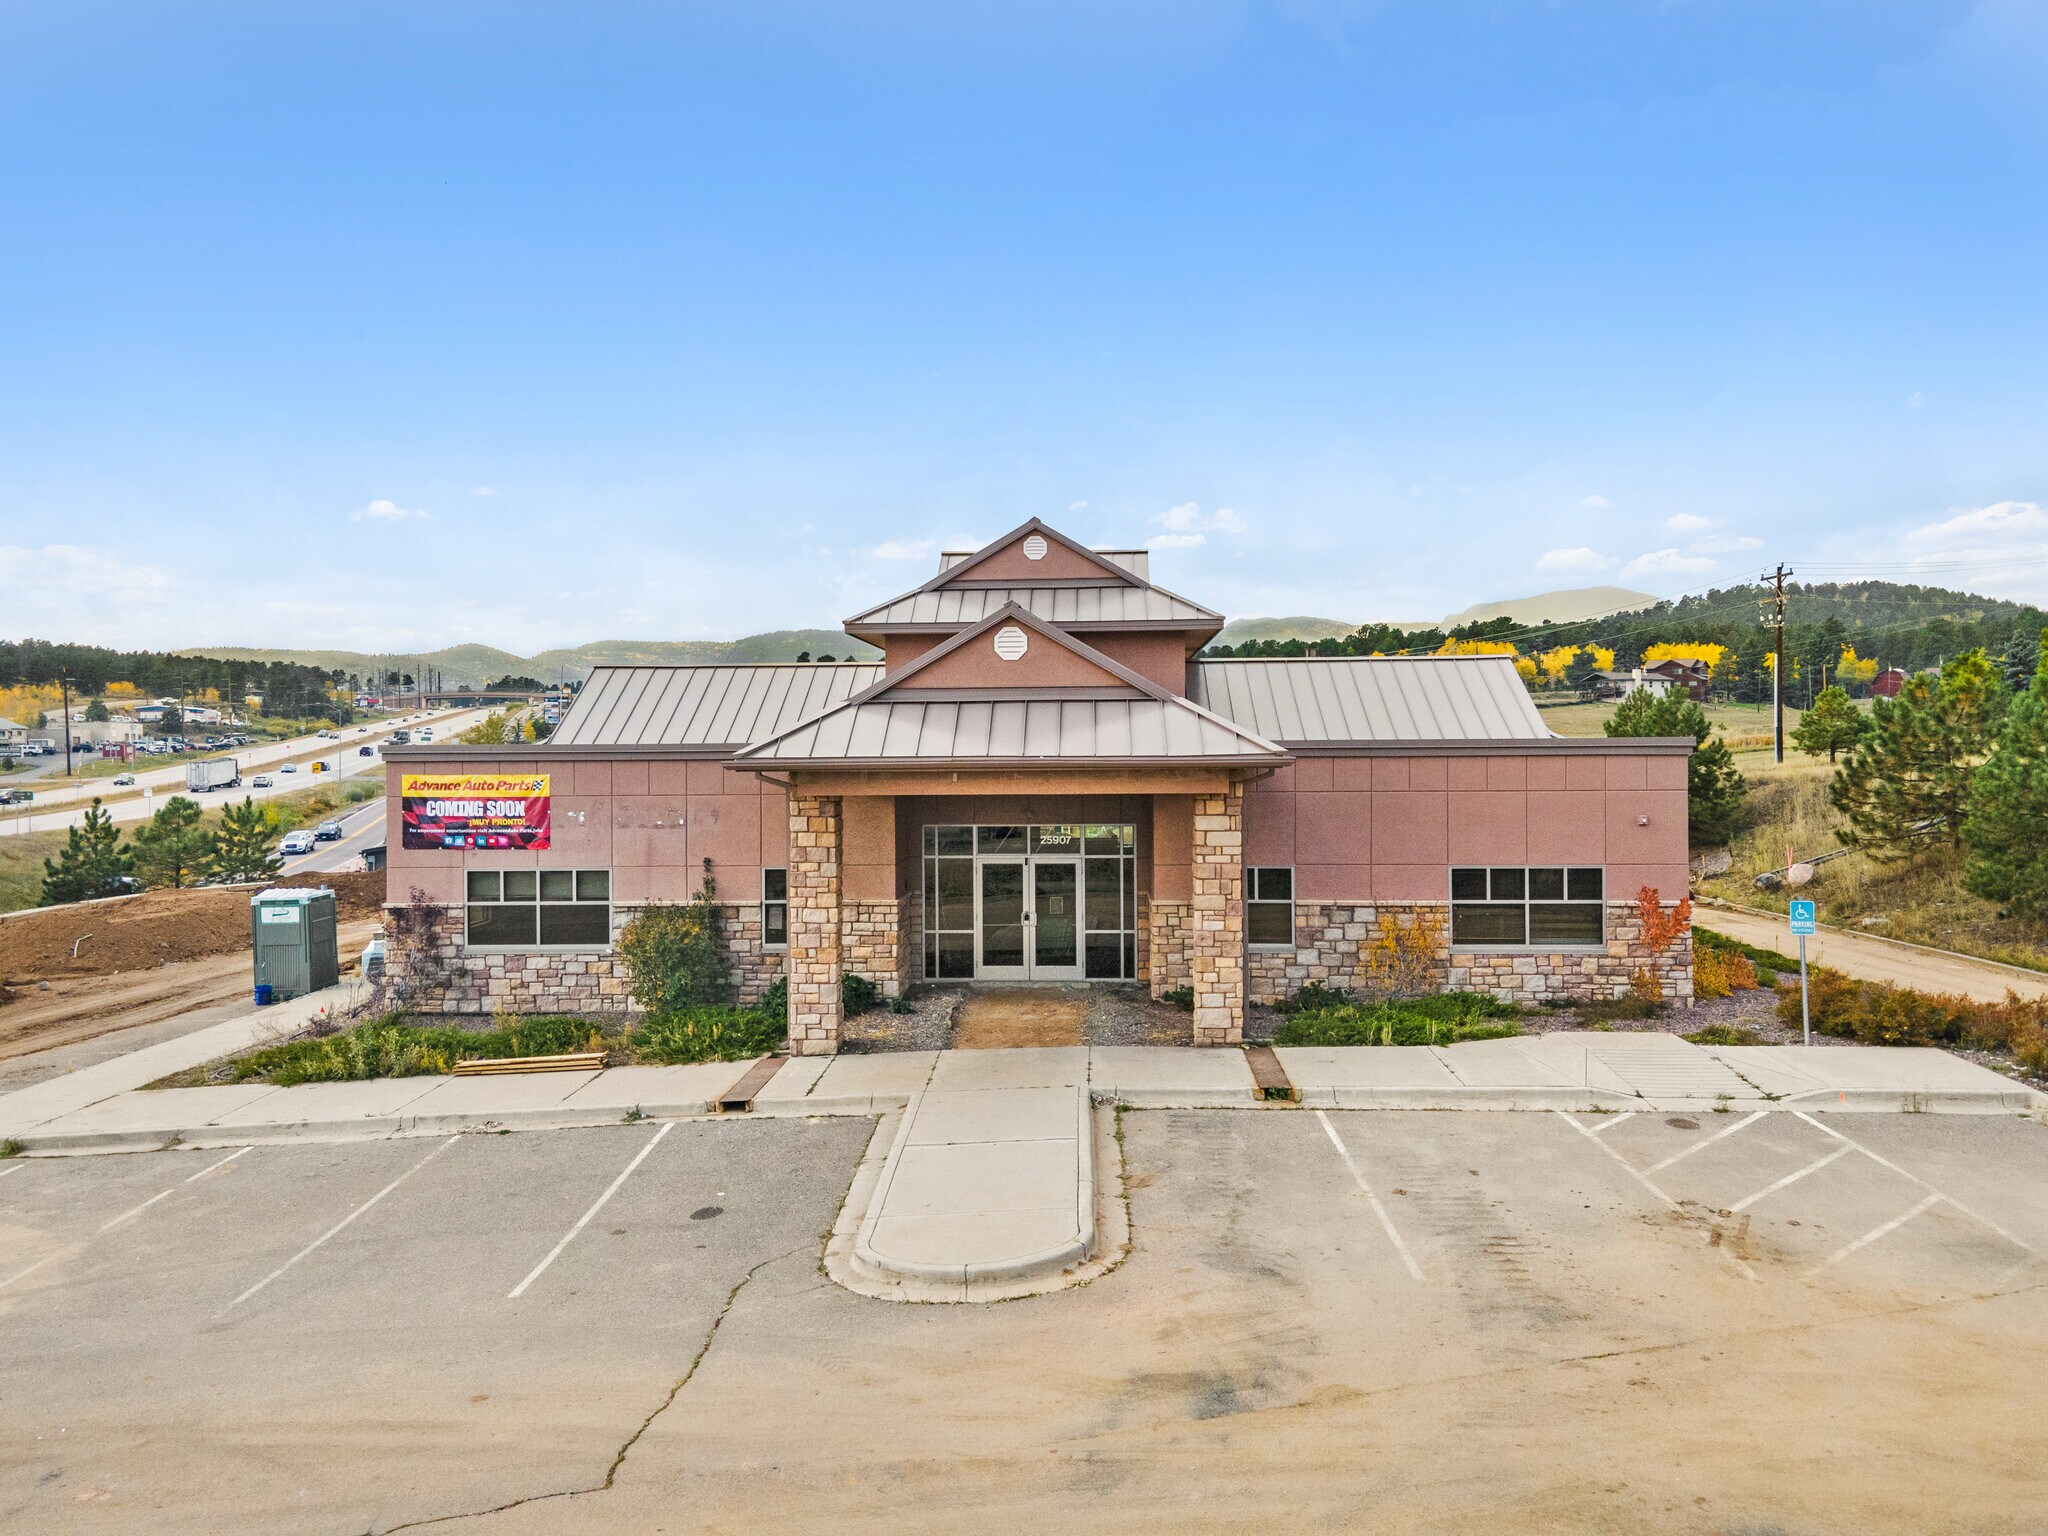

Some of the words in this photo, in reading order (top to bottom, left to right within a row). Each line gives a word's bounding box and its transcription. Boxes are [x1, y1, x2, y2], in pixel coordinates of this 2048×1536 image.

[407, 780, 461, 791] Advance
[462, 780, 494, 791] Auto
[495, 780, 531, 791] Parts
[426, 801, 483, 817] COMING
[486, 801, 526, 817] SOON
[1040, 836, 1072, 844] 25907
